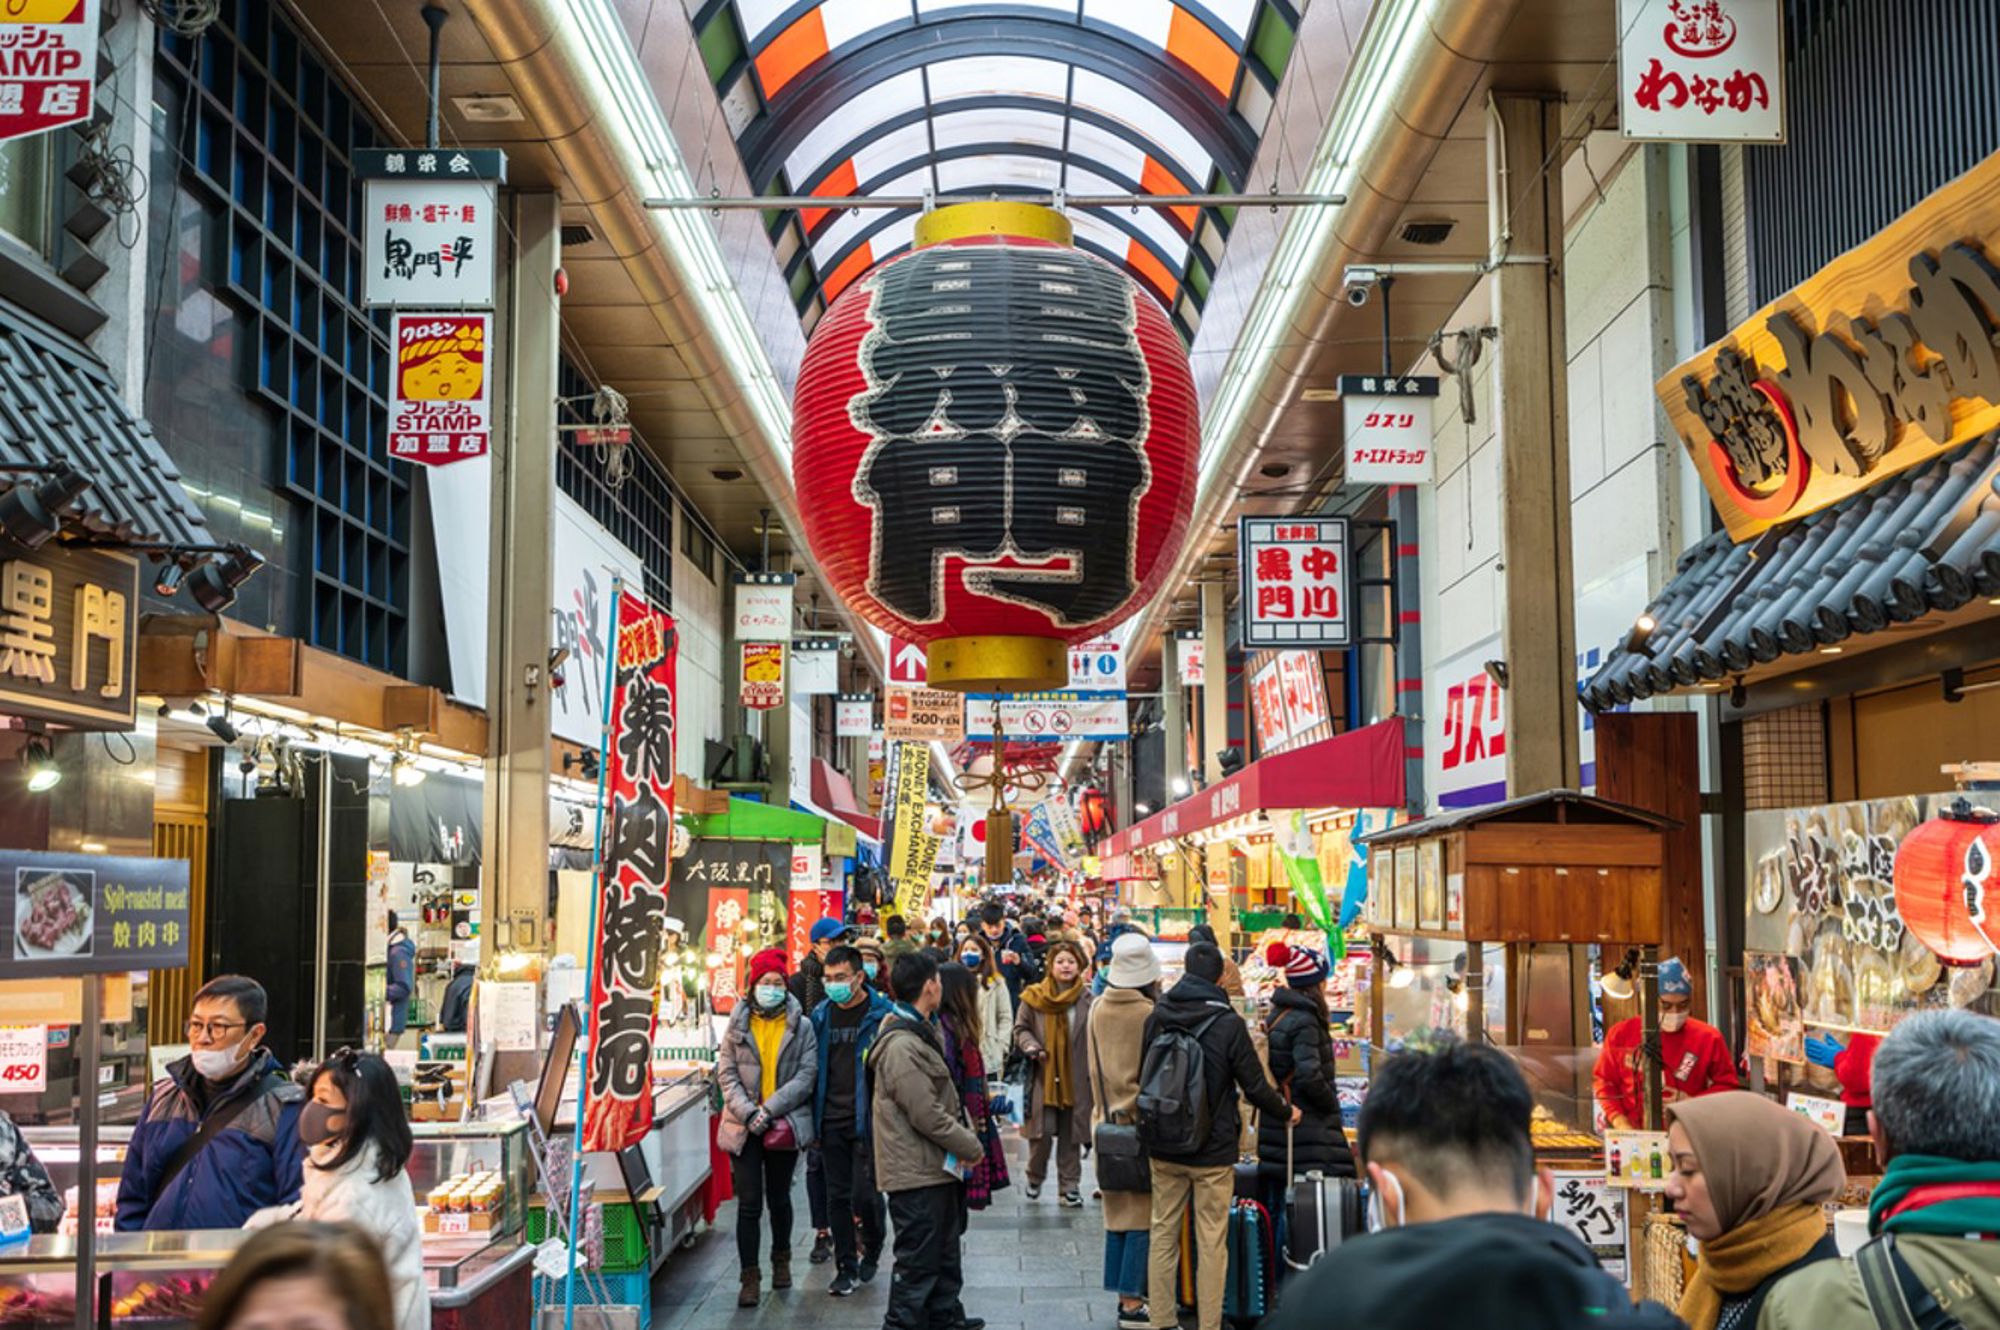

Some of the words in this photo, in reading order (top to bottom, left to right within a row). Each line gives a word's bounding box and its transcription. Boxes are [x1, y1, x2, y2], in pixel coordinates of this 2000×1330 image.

[1634, 58, 1769, 116] わなか
[402, 322, 457, 344] クロモン
[396, 415, 482, 431] STAMP
[1364, 413, 1415, 428] クスリ
[395, 435, 482, 453] 加盟店
[0, 559, 126, 698] 黒門
[112, 920, 180, 949] 焼肉串
[2, 1063, 40, 1082] 450
